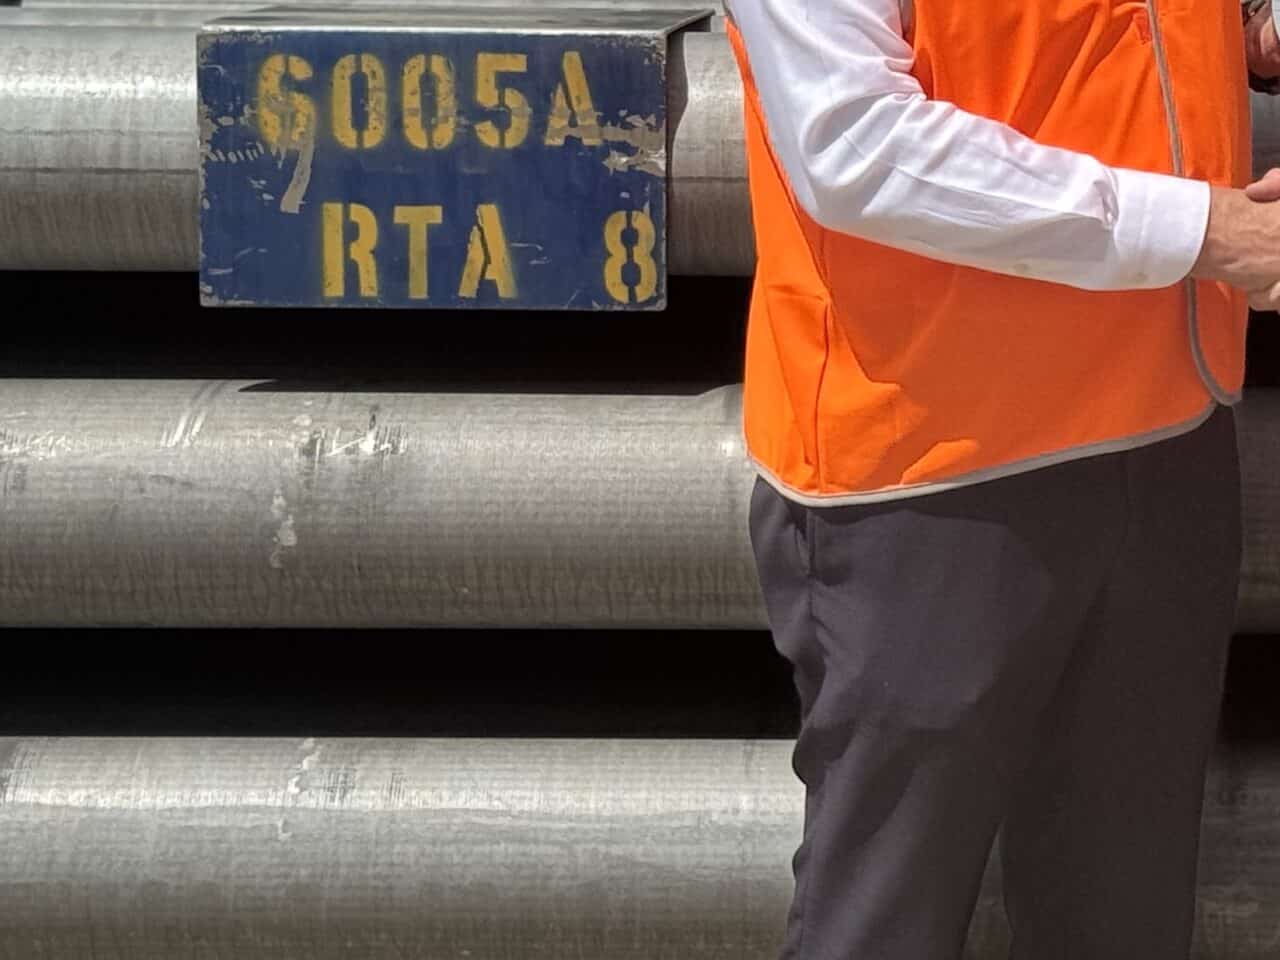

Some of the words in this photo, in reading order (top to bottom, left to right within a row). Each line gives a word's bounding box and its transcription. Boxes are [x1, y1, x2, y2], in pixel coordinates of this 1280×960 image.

[257, 51, 603, 149] 6005A
[322, 202, 518, 298] RTA
[603, 210, 658, 304] 8
